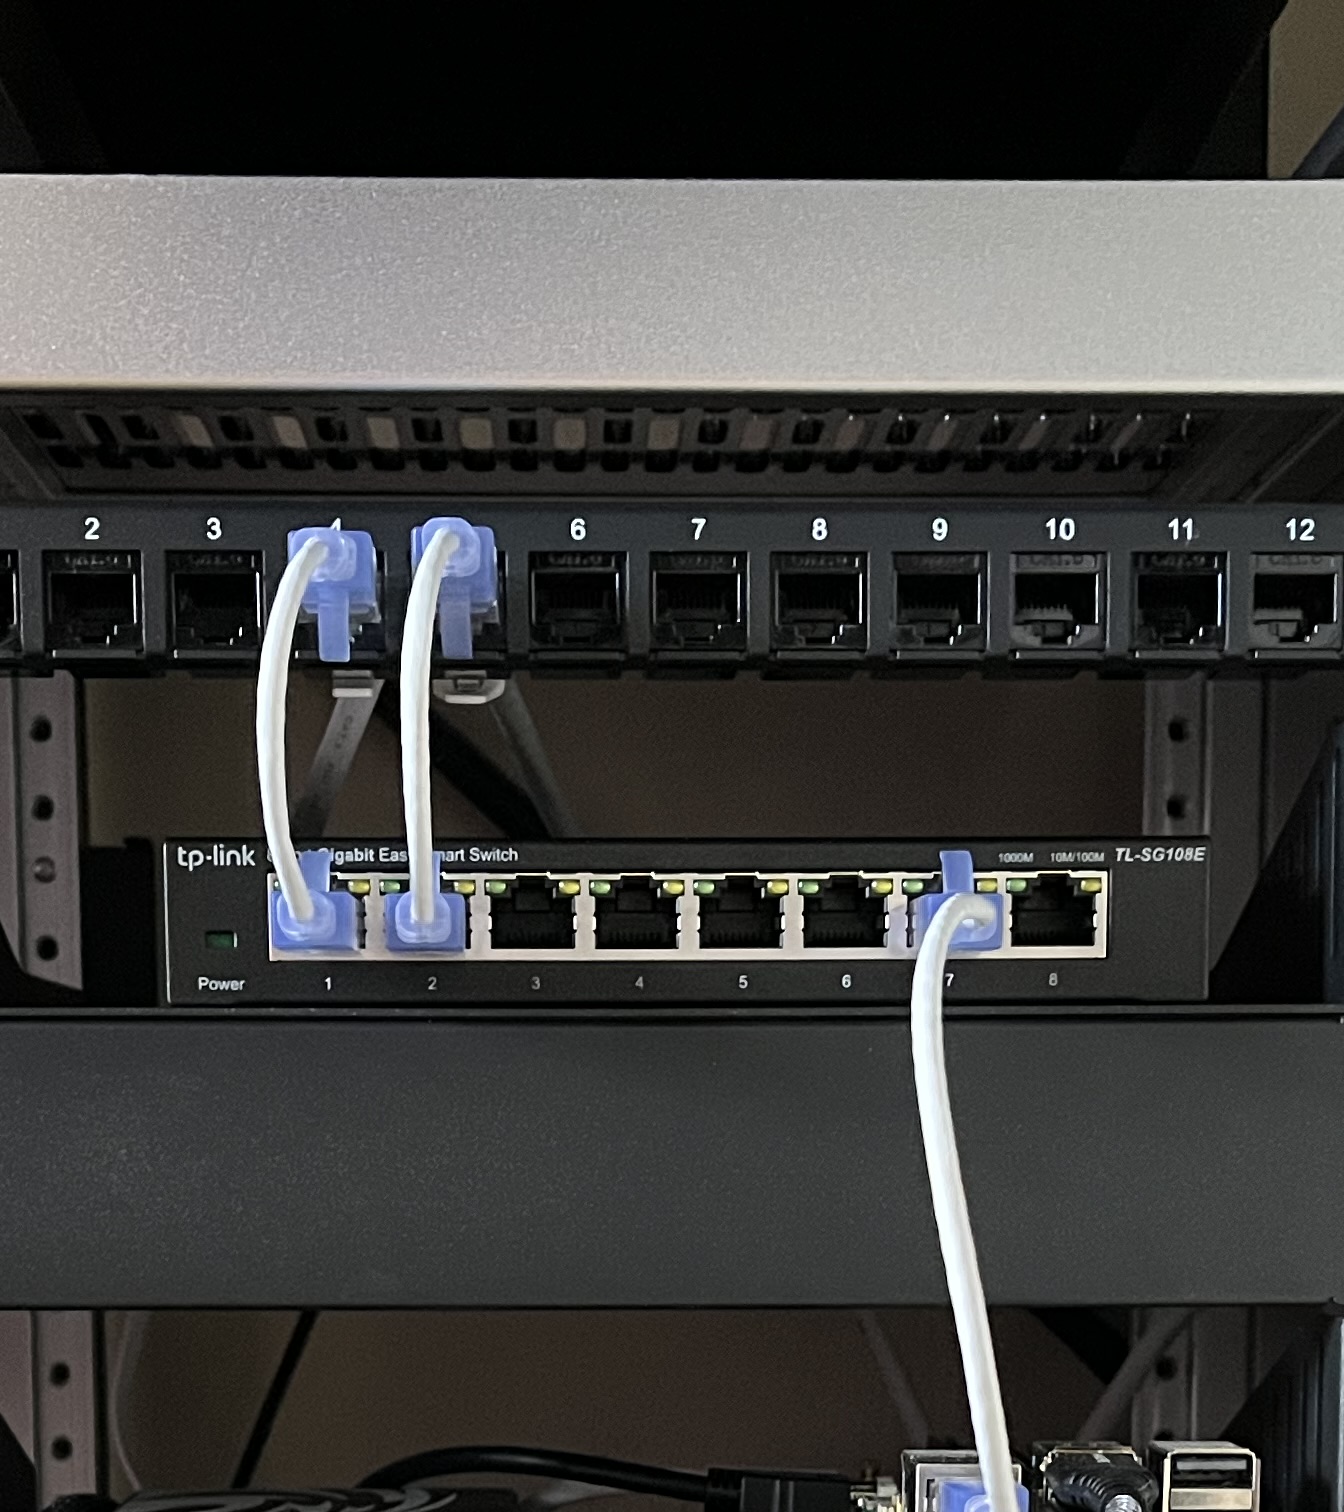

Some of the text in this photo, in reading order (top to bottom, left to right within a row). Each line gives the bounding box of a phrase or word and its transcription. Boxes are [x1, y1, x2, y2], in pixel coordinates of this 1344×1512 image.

[84, 517, 100, 540] 2
[206, 517, 222, 540] 3
[570, 518, 586, 541] 6
[691, 518, 707, 541] 7
[812, 517, 828, 541] 8
[932, 517, 948, 541] 9
[1045, 517, 1075, 541] 10
[1168, 518, 1193, 541] 11
[1285, 518, 1315, 541] 12
[177, 843, 256, 872] tp-link
[378, 846, 409, 862] Eas
[469, 847, 519, 862] Switch
[1115, 847, 1207, 862] TL-SG108E
[198, 976, 246, 991] Power
[324, 972, 1058, 991] 1 2 3 4 5 6 7 8
